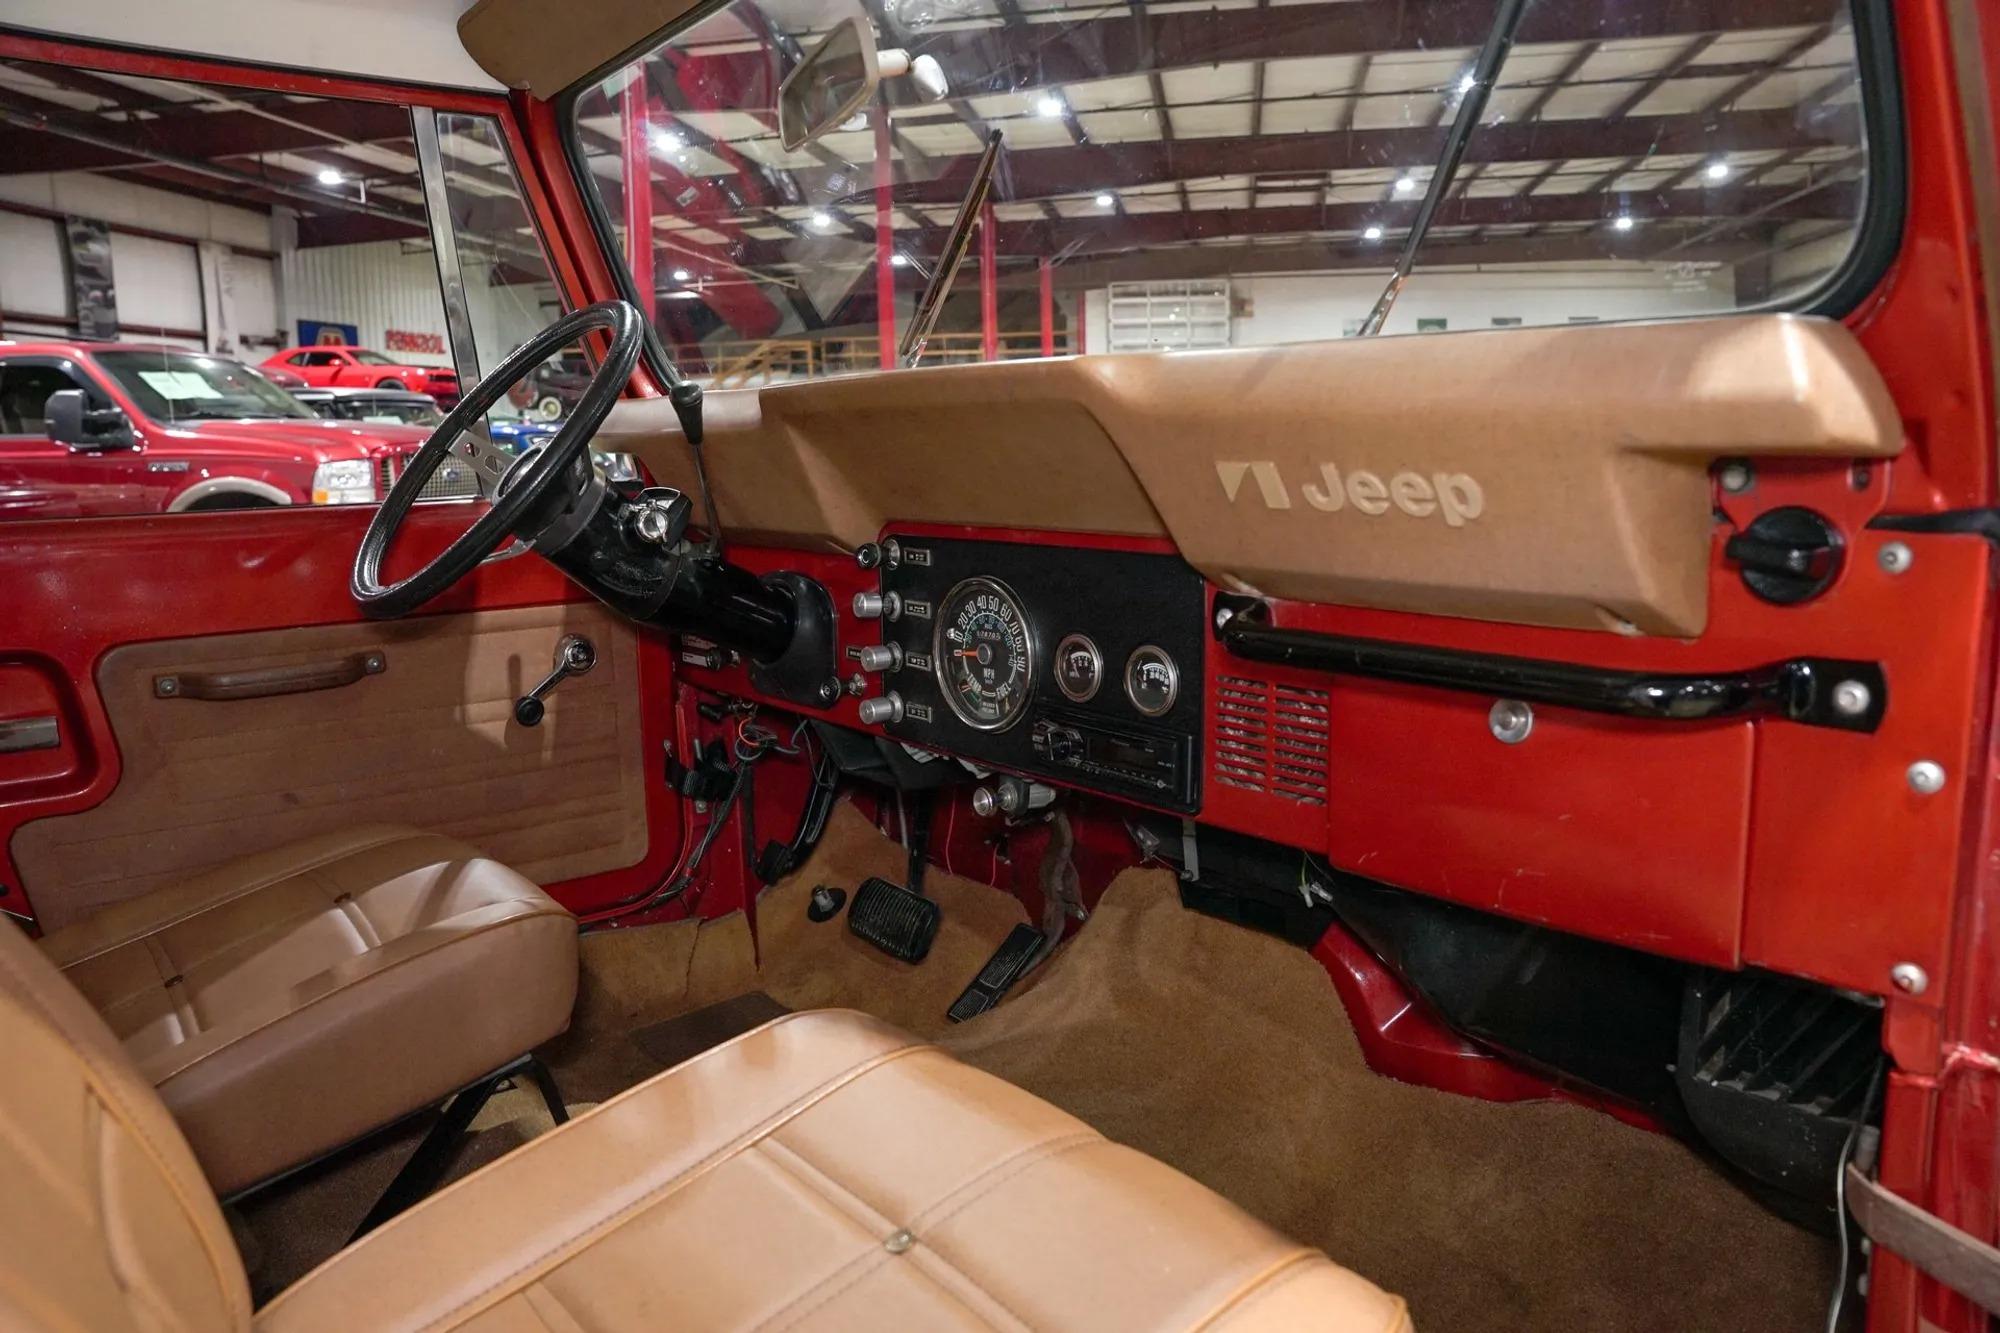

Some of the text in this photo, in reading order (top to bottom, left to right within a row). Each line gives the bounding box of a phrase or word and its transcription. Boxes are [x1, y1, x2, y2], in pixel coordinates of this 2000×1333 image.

[1302, 462, 1484, 527] Jeep
[965, 601, 977, 618] 30
[977, 595, 987, 609] 40
[989, 596, 999, 611] 50
[957, 612, 968, 629] 20
[1000, 604, 1012, 621] 60
[1010, 621, 1020, 635] 70
[953, 630, 964, 643] 10
[1015, 636, 1025, 652] 80
[1017, 656, 1026, 672] 90
[983, 668, 995, 679] MPH
